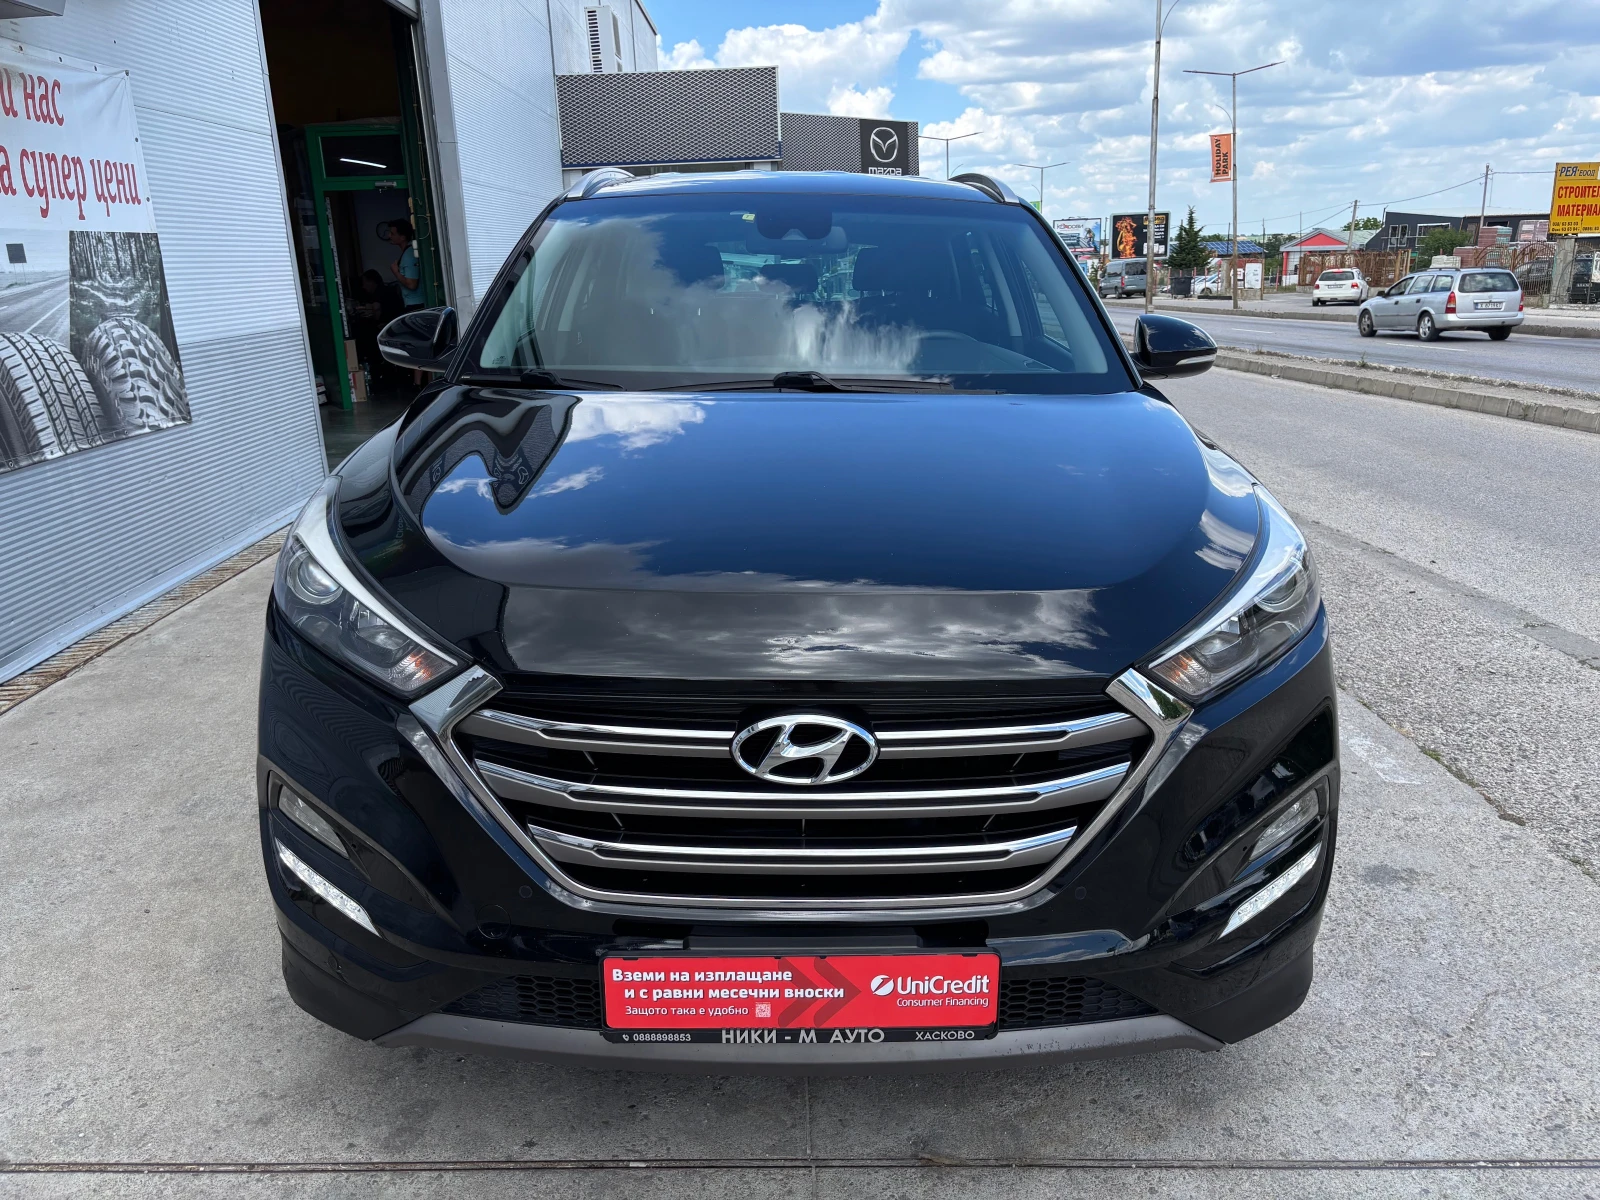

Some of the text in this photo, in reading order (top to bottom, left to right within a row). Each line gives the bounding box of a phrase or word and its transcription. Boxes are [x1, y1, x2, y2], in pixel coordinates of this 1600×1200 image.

[19, 72, 65, 127] нас
[1214, 138, 1222, 176] HOLIDAY
[0, 145, 142, 221] а супер цени
[612, 968, 792, 983] Вземи на изплащане
[896, 975, 990, 995] UniCredit
[624, 987, 844, 1001] и с равни месечни вноски
[896, 997, 989, 1008] Consumer Financing
[625, 1006, 749, 1017] Защото така е удобно
[633, 1033, 692, 1042] 0888898853
[721, 1028, 777, 1044] НИКИ
[798, 1028, 817, 1044] М
[830, 1028, 885, 1044] АУТО
[915, 1030, 975, 1041] ХАСКОВО
